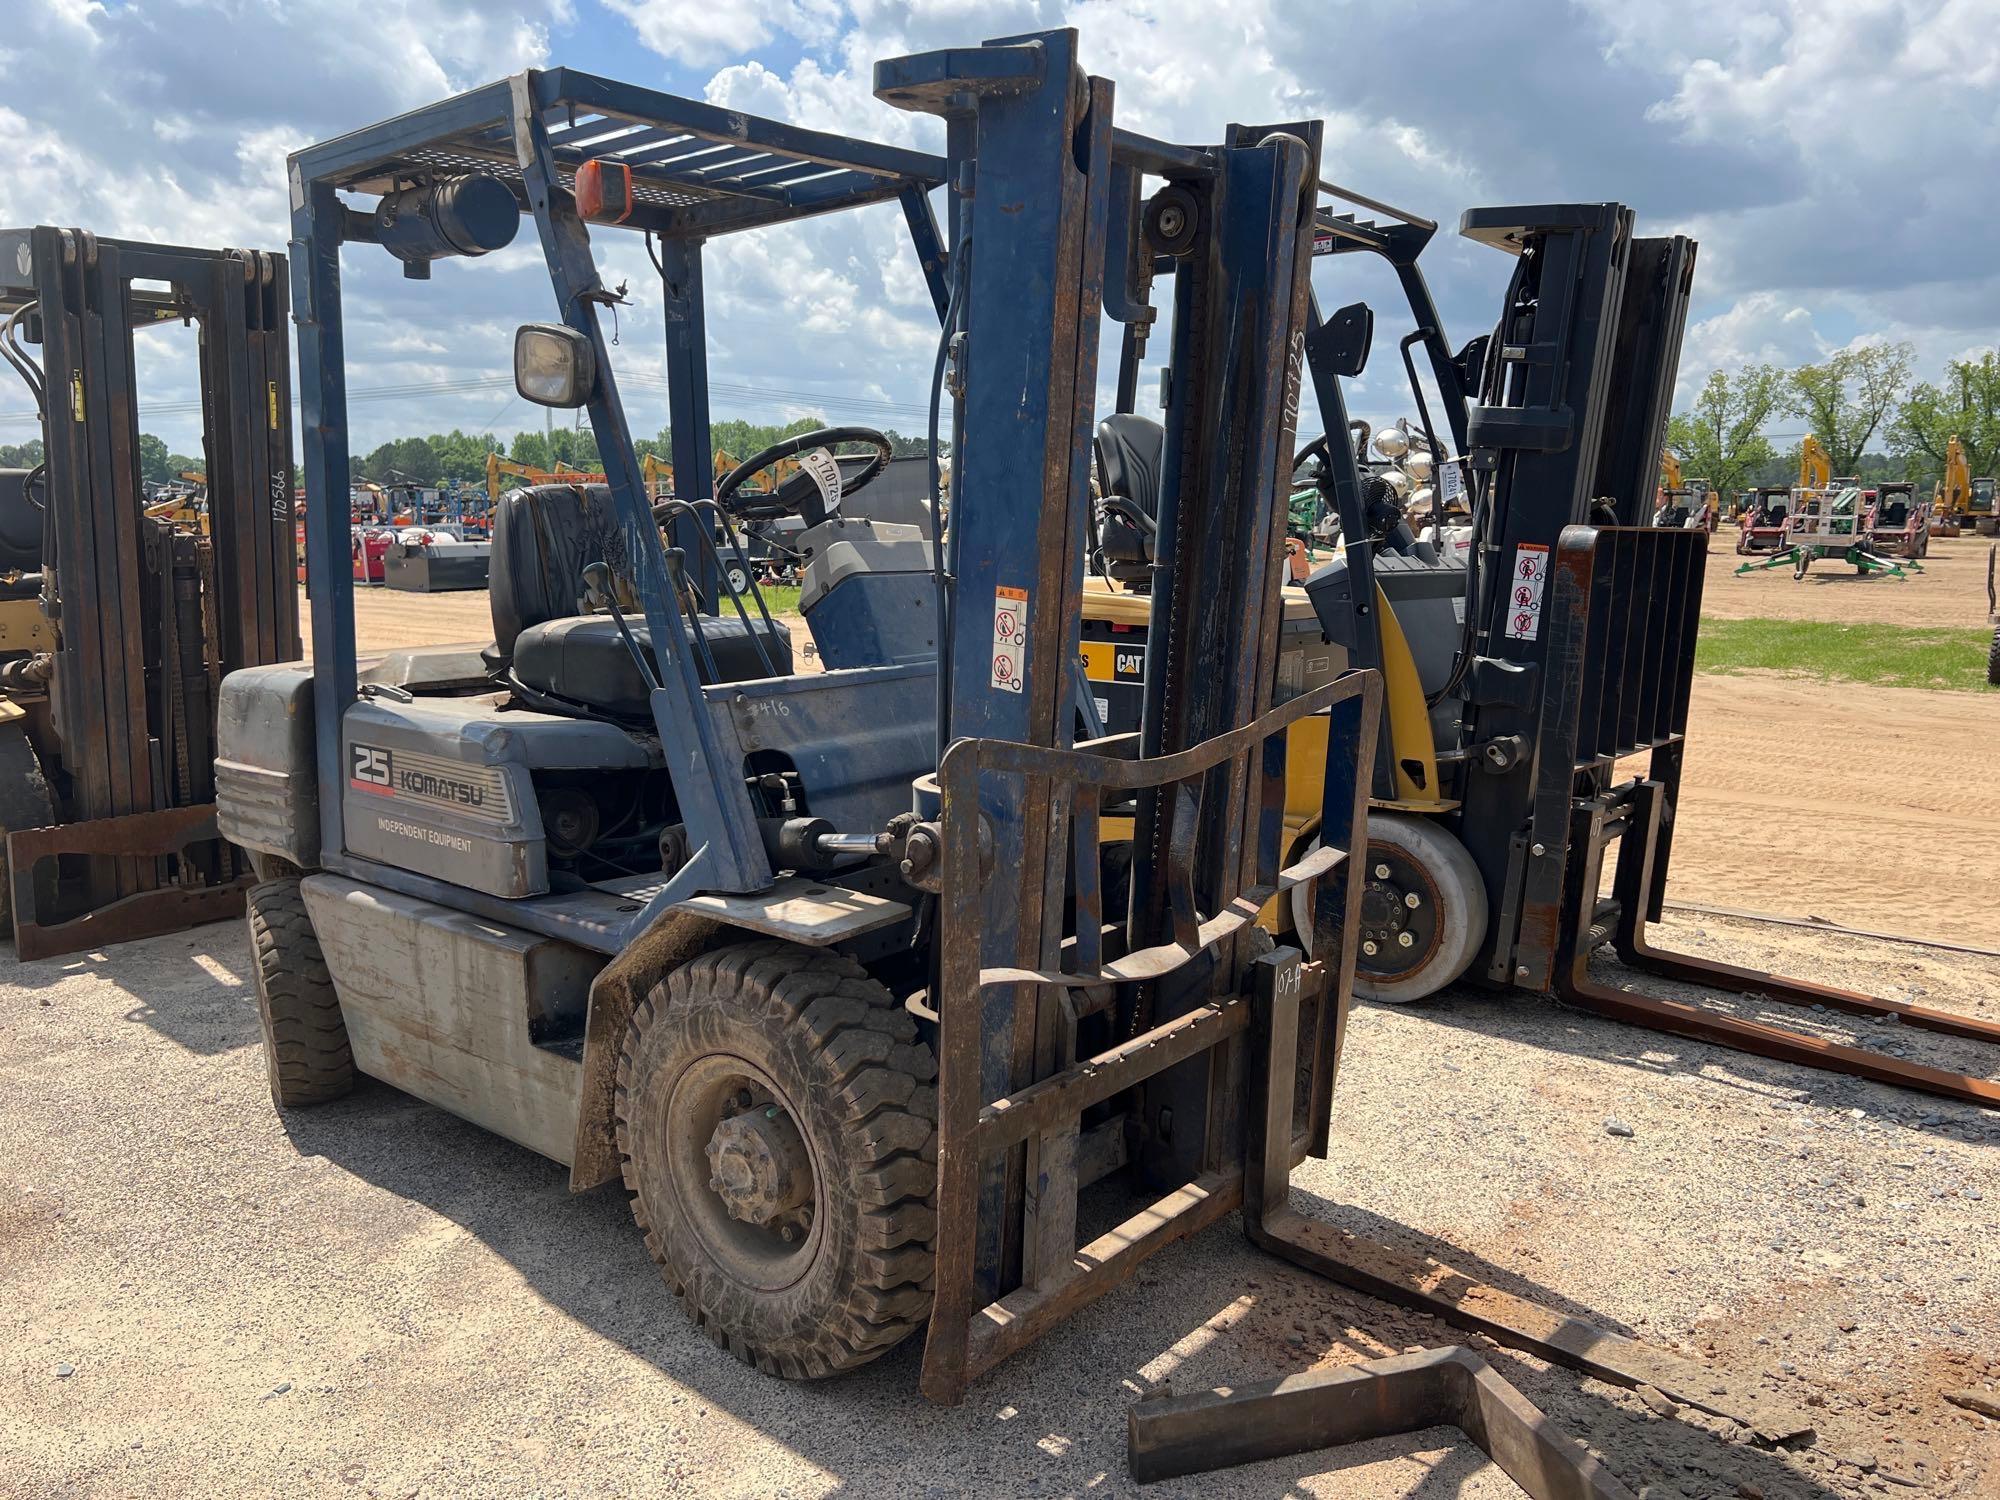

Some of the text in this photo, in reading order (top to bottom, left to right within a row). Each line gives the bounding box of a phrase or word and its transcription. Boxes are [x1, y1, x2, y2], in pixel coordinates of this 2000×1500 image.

[271, 470, 288, 522] 170566
[818, 460, 839, 503] 170725
[1116, 653, 1143, 674] CAT
[355, 746, 389, 786] 25
[400, 770, 484, 806] KOMATSU
[378, 817, 472, 853] INDEPENDENT EQUIPMENT
